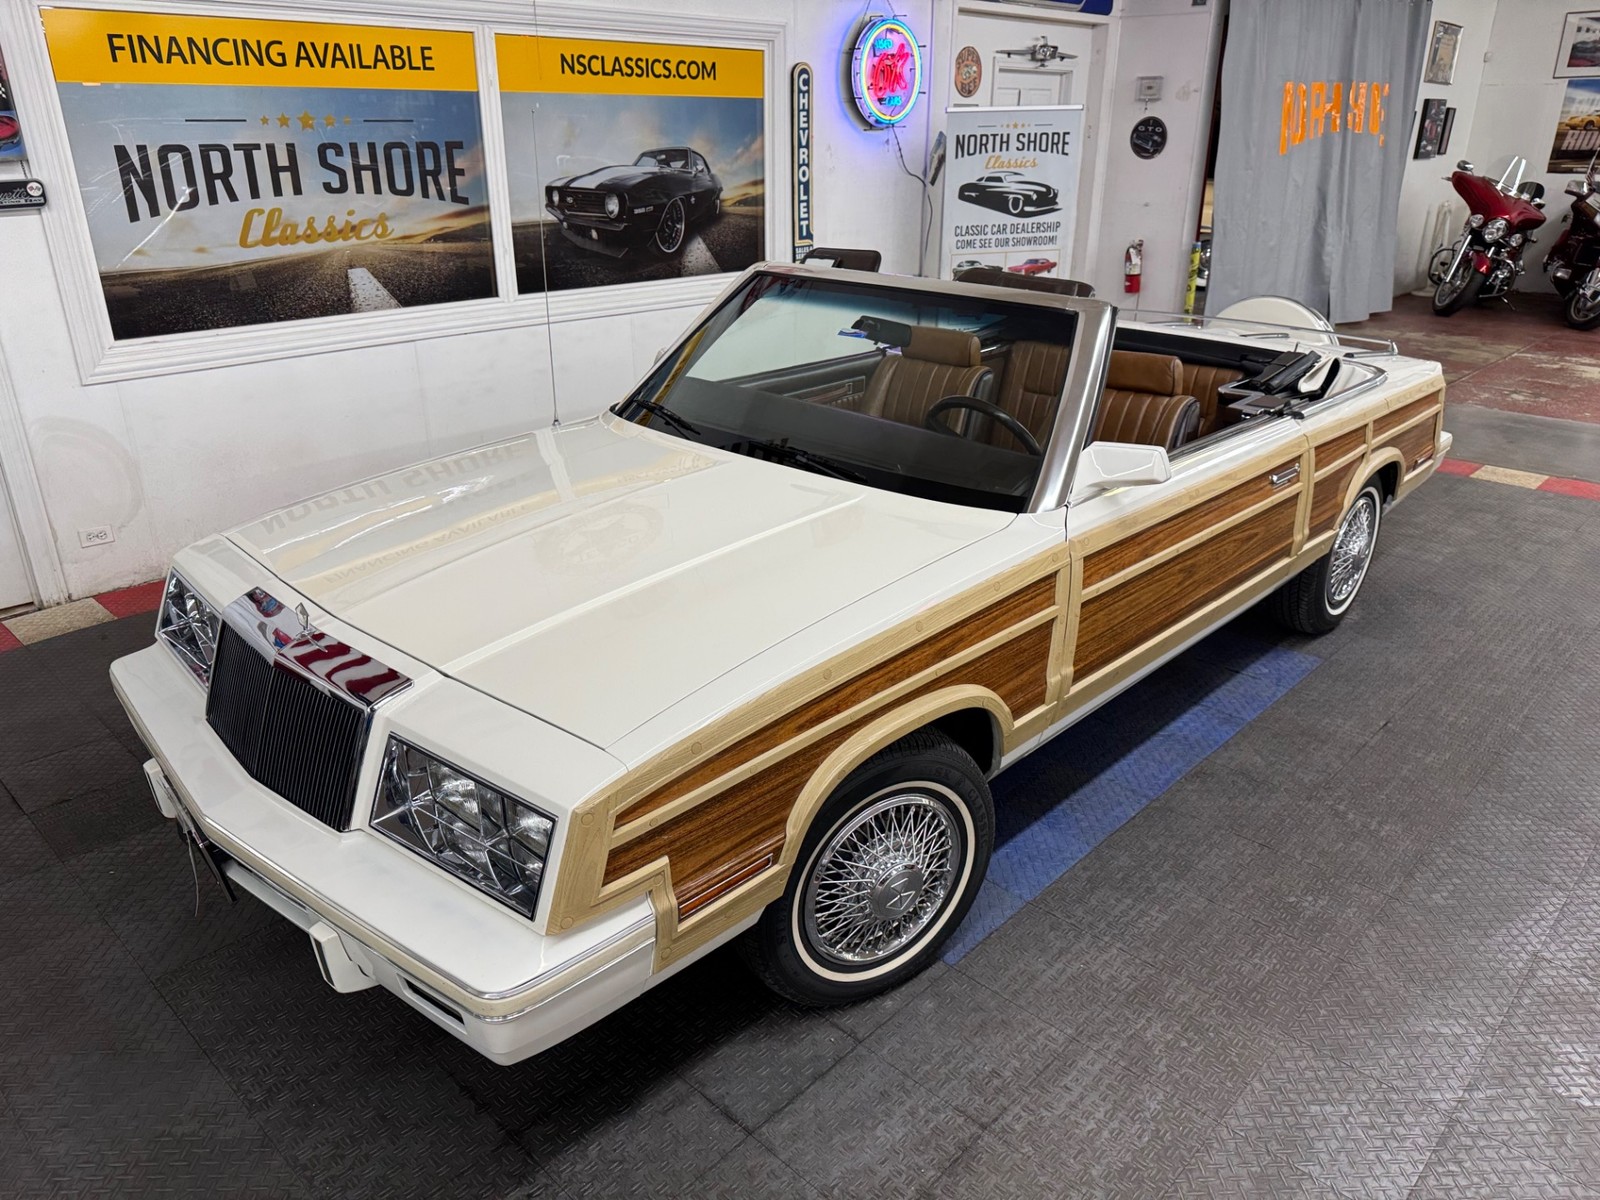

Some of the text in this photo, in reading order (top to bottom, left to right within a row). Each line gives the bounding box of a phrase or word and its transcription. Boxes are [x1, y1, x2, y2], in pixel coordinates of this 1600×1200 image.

[106, 33, 436, 72] FINANCING AVAILABLE
[559, 53, 717, 81] NSCLASSICS.COM
[798, 73, 811, 238] CHEVROLET
[954, 132, 1071, 160] NORTH SHORE
[984, 155, 1039, 170] Classics
[113, 141, 470, 224] NORTH SHORE
[238, 207, 394, 249] Classics
[954, 221, 1061, 237] CLASSIC CAR DEALERSHIP
[956, 235, 1057, 250] COME SEE OUR SHOWROOM!
